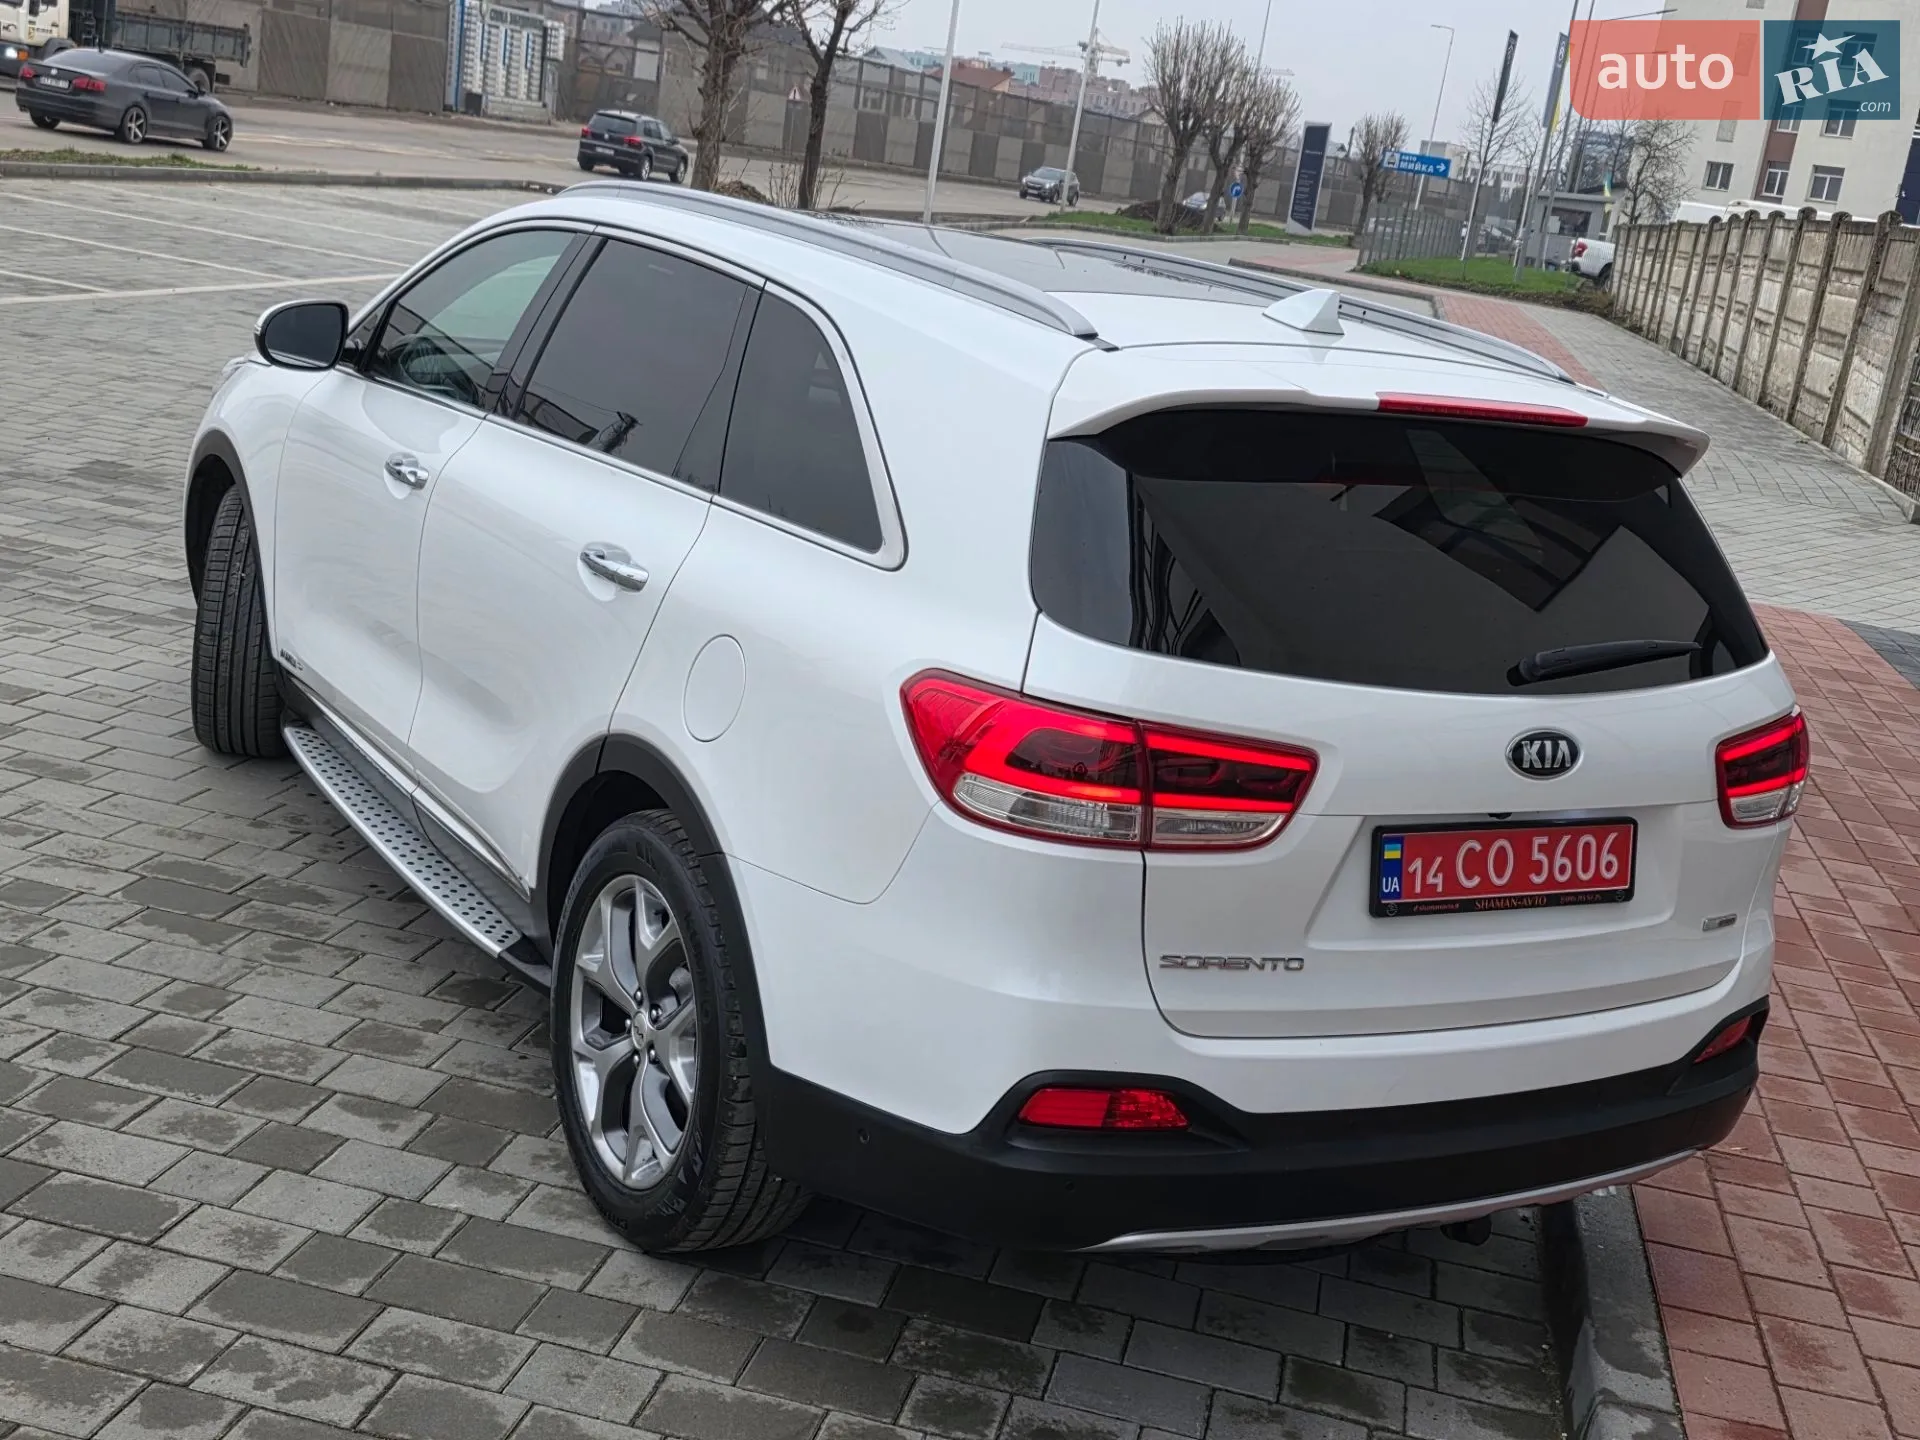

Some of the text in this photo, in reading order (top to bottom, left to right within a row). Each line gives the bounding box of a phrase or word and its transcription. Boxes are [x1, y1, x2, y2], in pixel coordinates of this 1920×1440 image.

[1521, 740, 1571, 769] KIA
[1408, 832, 1618, 894] 14 CO 5606
[1382, 876, 1400, 893] UA
[1474, 895, 1548, 910] SHAMAN-AVTO
[1159, 955, 1305, 971] SORENTO
